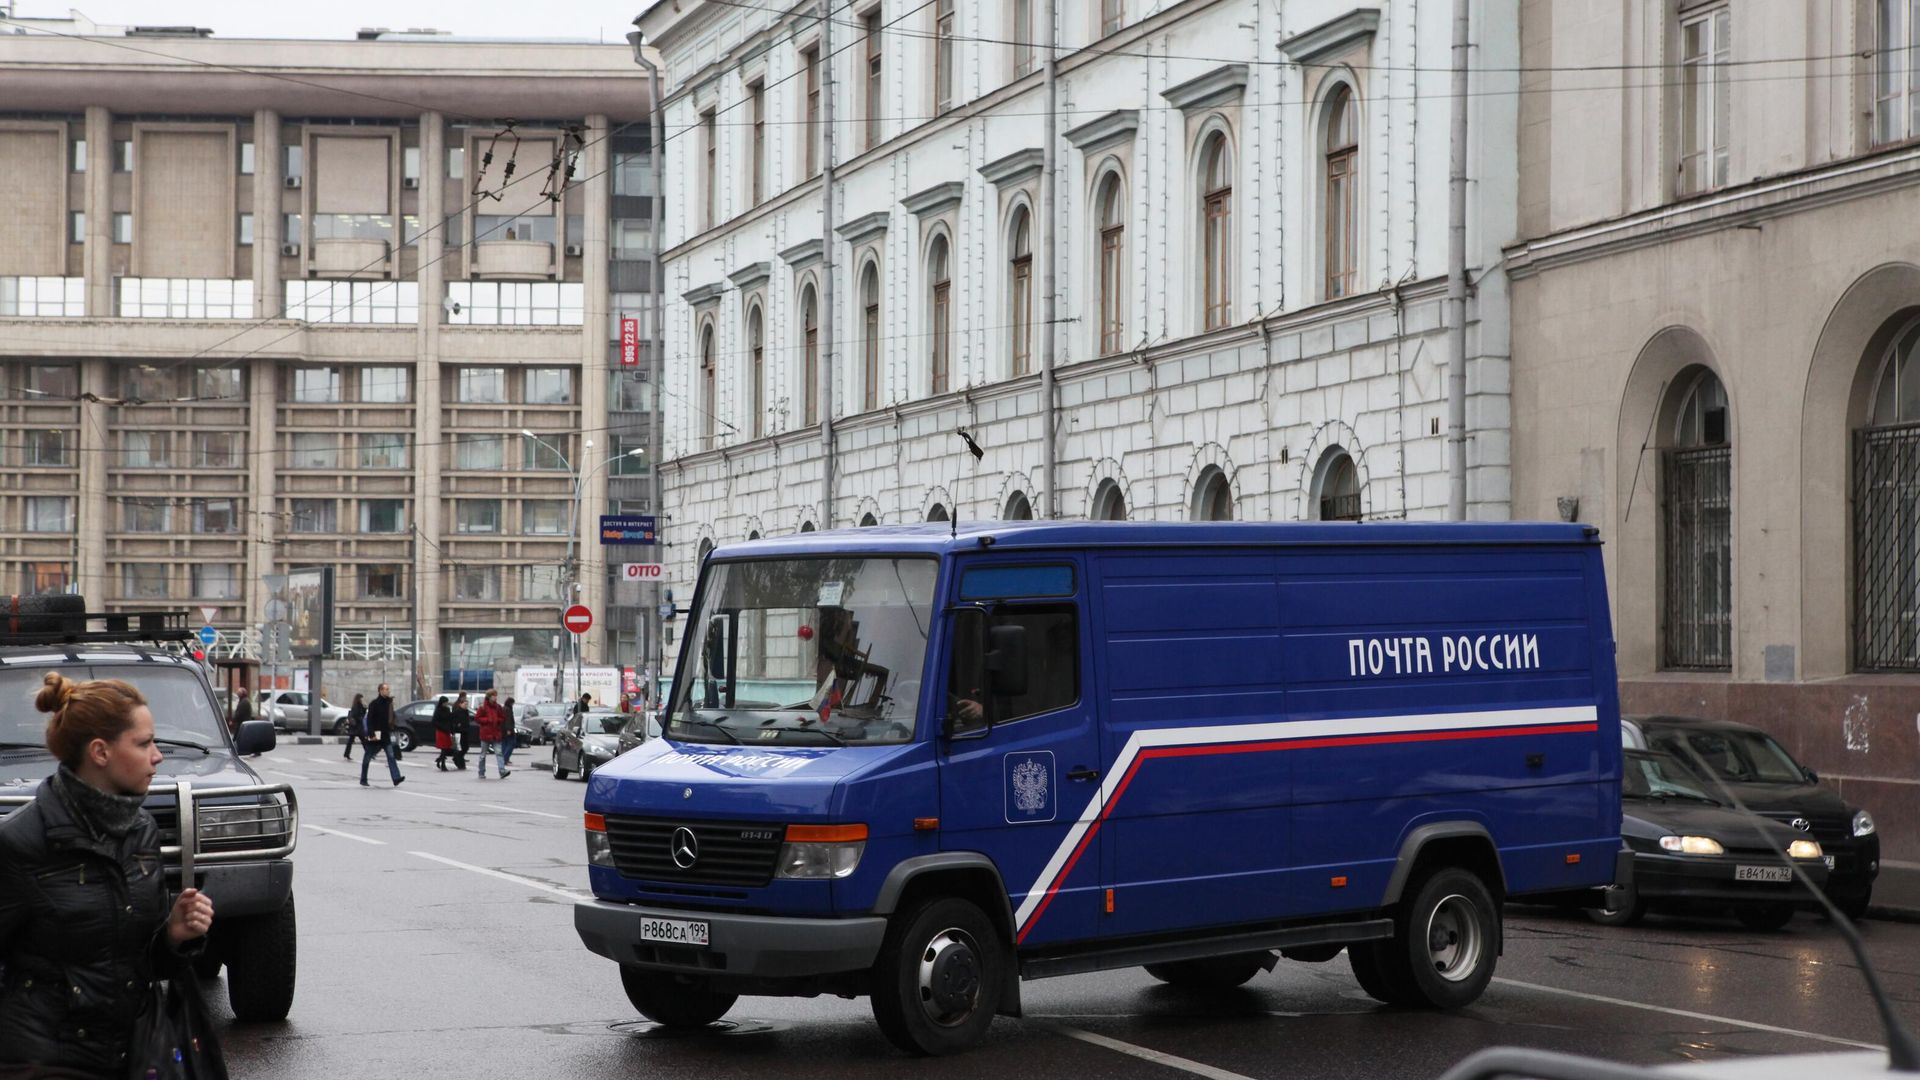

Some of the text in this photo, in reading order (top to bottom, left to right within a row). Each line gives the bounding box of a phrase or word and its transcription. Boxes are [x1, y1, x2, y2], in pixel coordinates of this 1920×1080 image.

[624, 321, 635, 363] 995 22 25
[628, 564, 661, 577] OTTO
[1348, 633, 1540, 676] ПОЧТА РОССИИ
[652, 753, 721, 766] ПОЧТА
[1780, 868, 1789, 877] 32
[689, 923, 706, 938] 199
